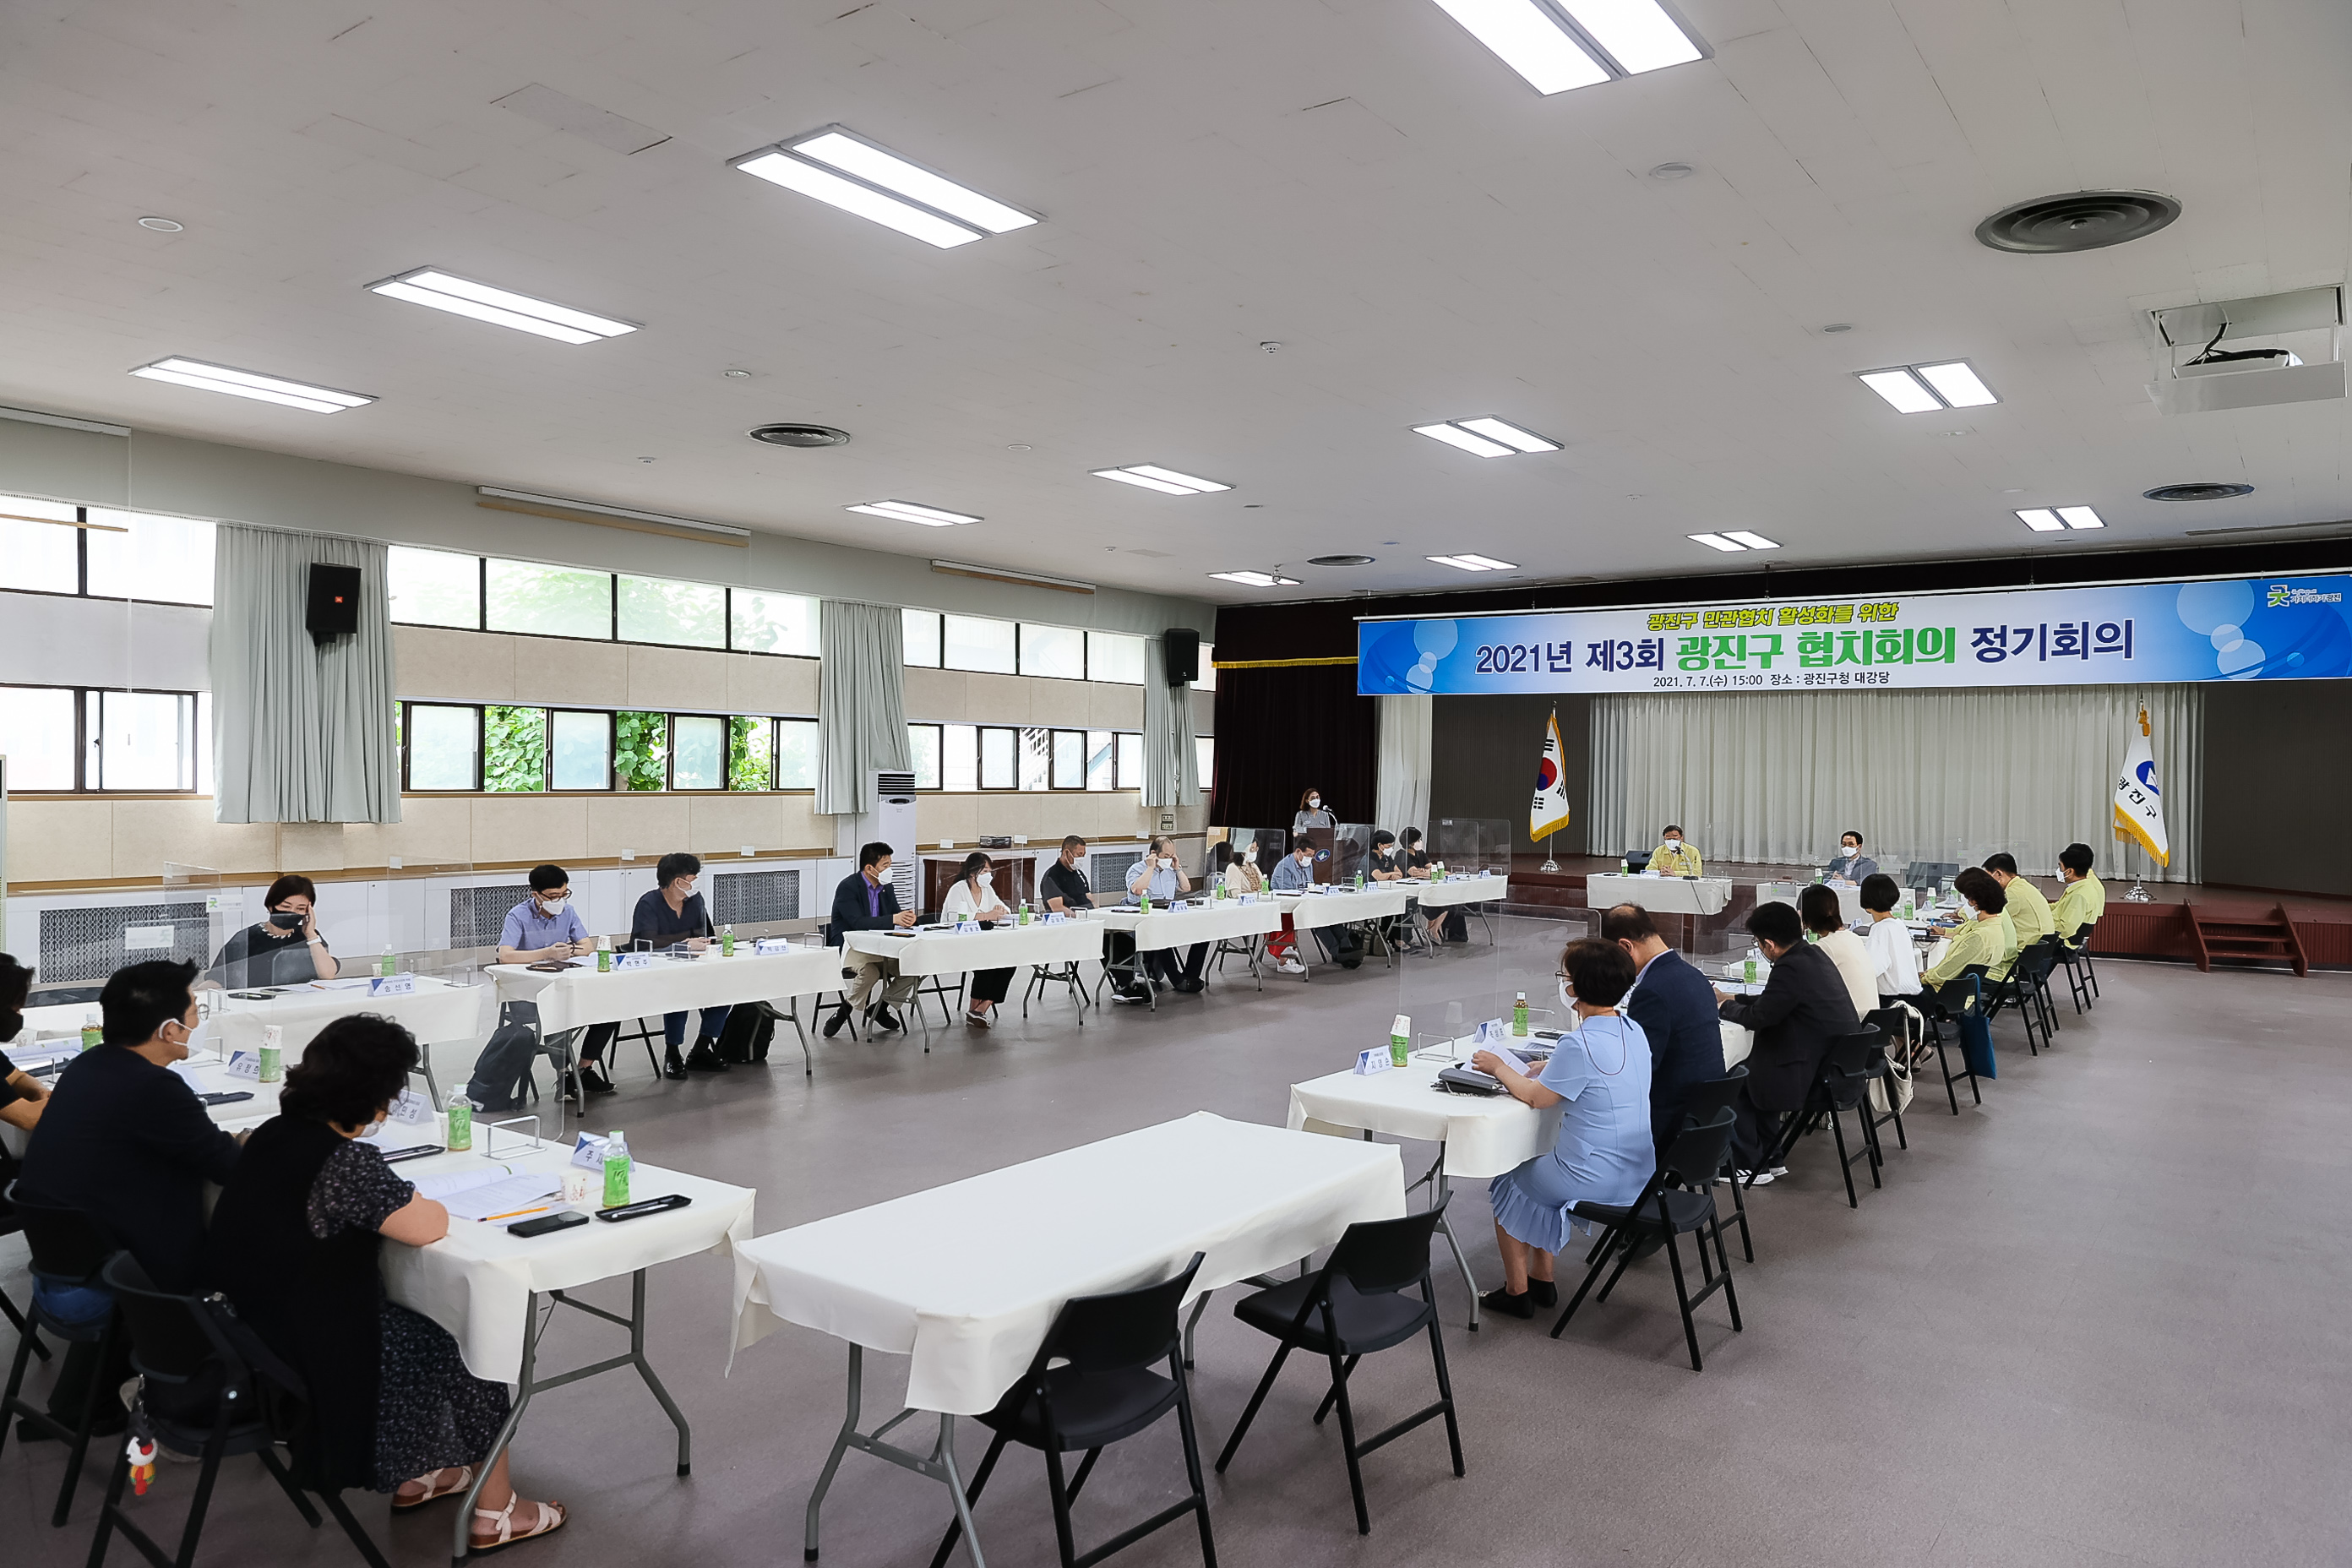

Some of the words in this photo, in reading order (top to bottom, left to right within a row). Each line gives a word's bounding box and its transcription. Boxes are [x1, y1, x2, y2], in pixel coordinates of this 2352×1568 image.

[2327, 593, 2341, 602] 광진
[1647, 612, 1698, 631] 광진구
[1703, 607, 1773, 629] 민관협치
[1778, 604, 1855, 626] 활성화를
[1858, 602, 1900, 623] 위한
[1475, 640, 1572, 674] 2021년
[1586, 637, 1663, 671] 제3회
[1675, 633, 1784, 671] 광진구
[1797, 627, 1956, 668] 협치회의
[1970, 618, 2134, 662] 정기회의
[1733, 674, 1762, 686] 15:00
[1770, 673, 1793, 685] 장소
[1803, 672, 1849, 685] 광진구청
[1854, 671, 1890, 684] 대강당
